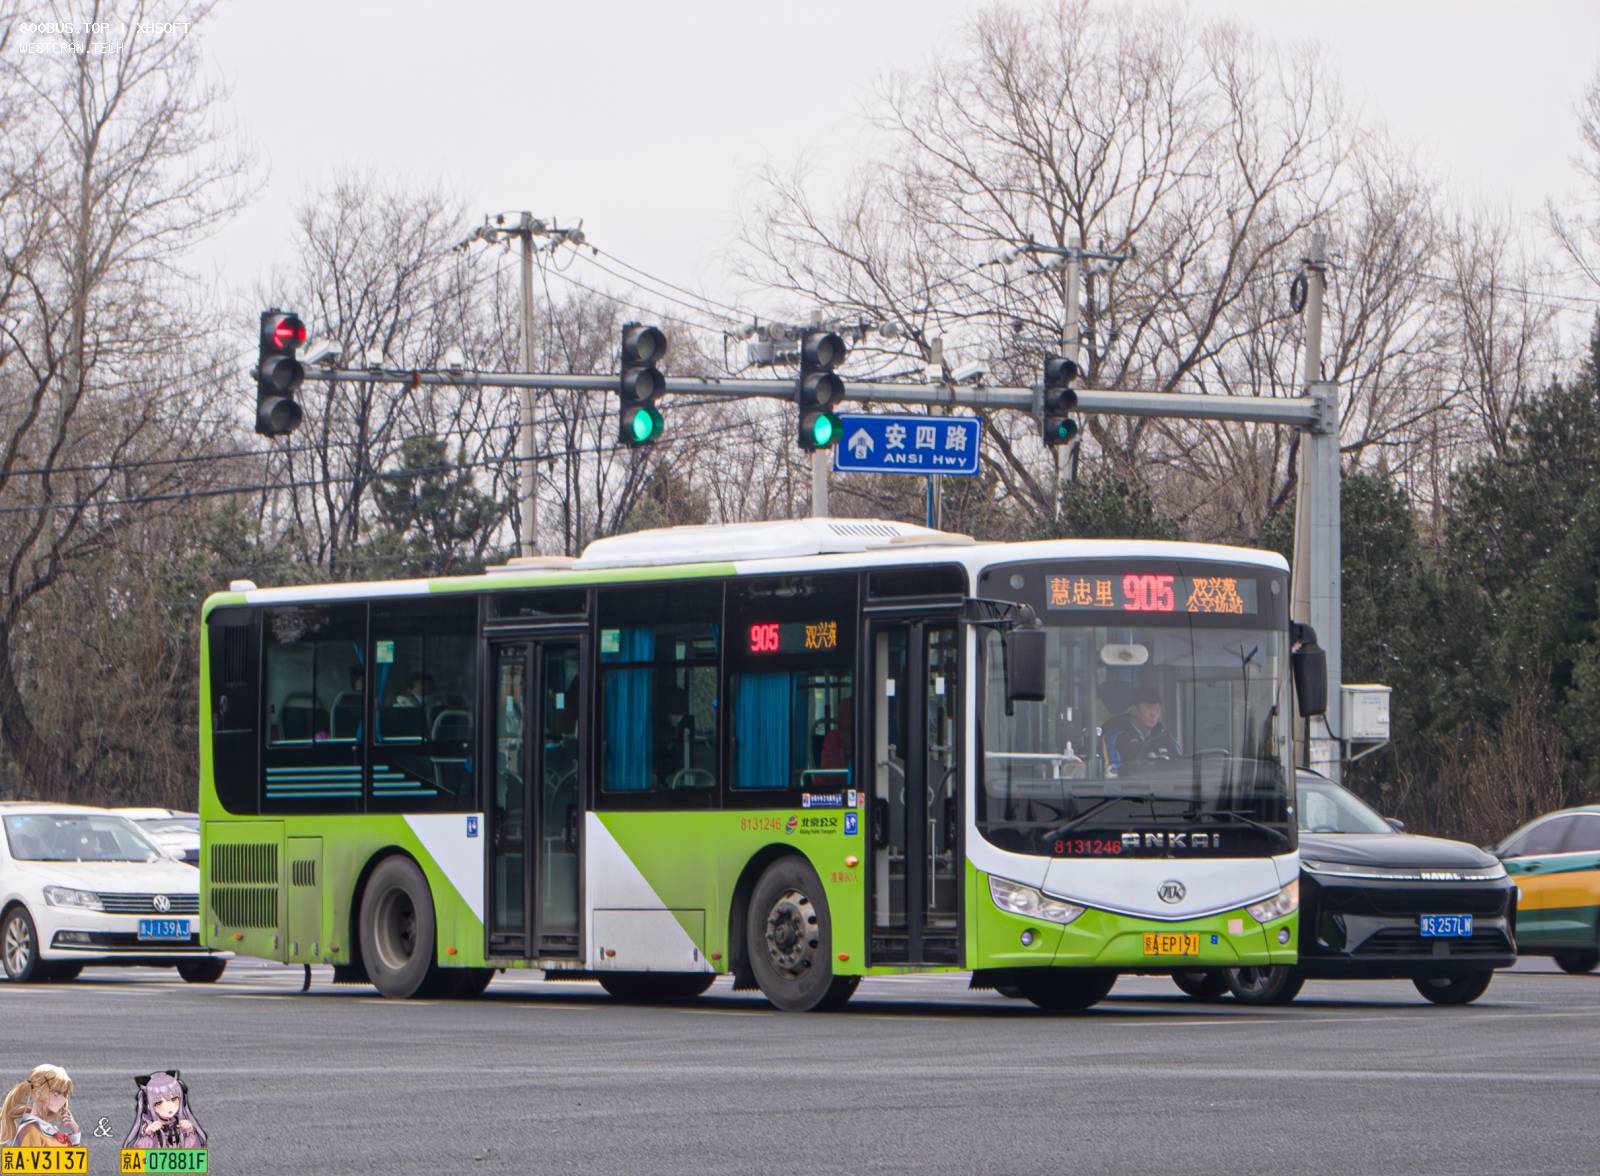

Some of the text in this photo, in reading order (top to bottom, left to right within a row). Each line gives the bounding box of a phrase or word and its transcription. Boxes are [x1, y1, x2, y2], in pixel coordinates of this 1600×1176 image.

[885, 423, 968, 451] 安四路
[883, 453, 968, 467] ANSI Hwy
[1050, 574, 1176, 612] 慧忠里 905
[750, 623, 780, 652] 905
[740, 816, 782, 831] 8131246
[800, 816, 838, 828] 北京公交
[1054, 839, 1122, 855] 8131246
[1121, 832, 1221, 849] ANKAI
